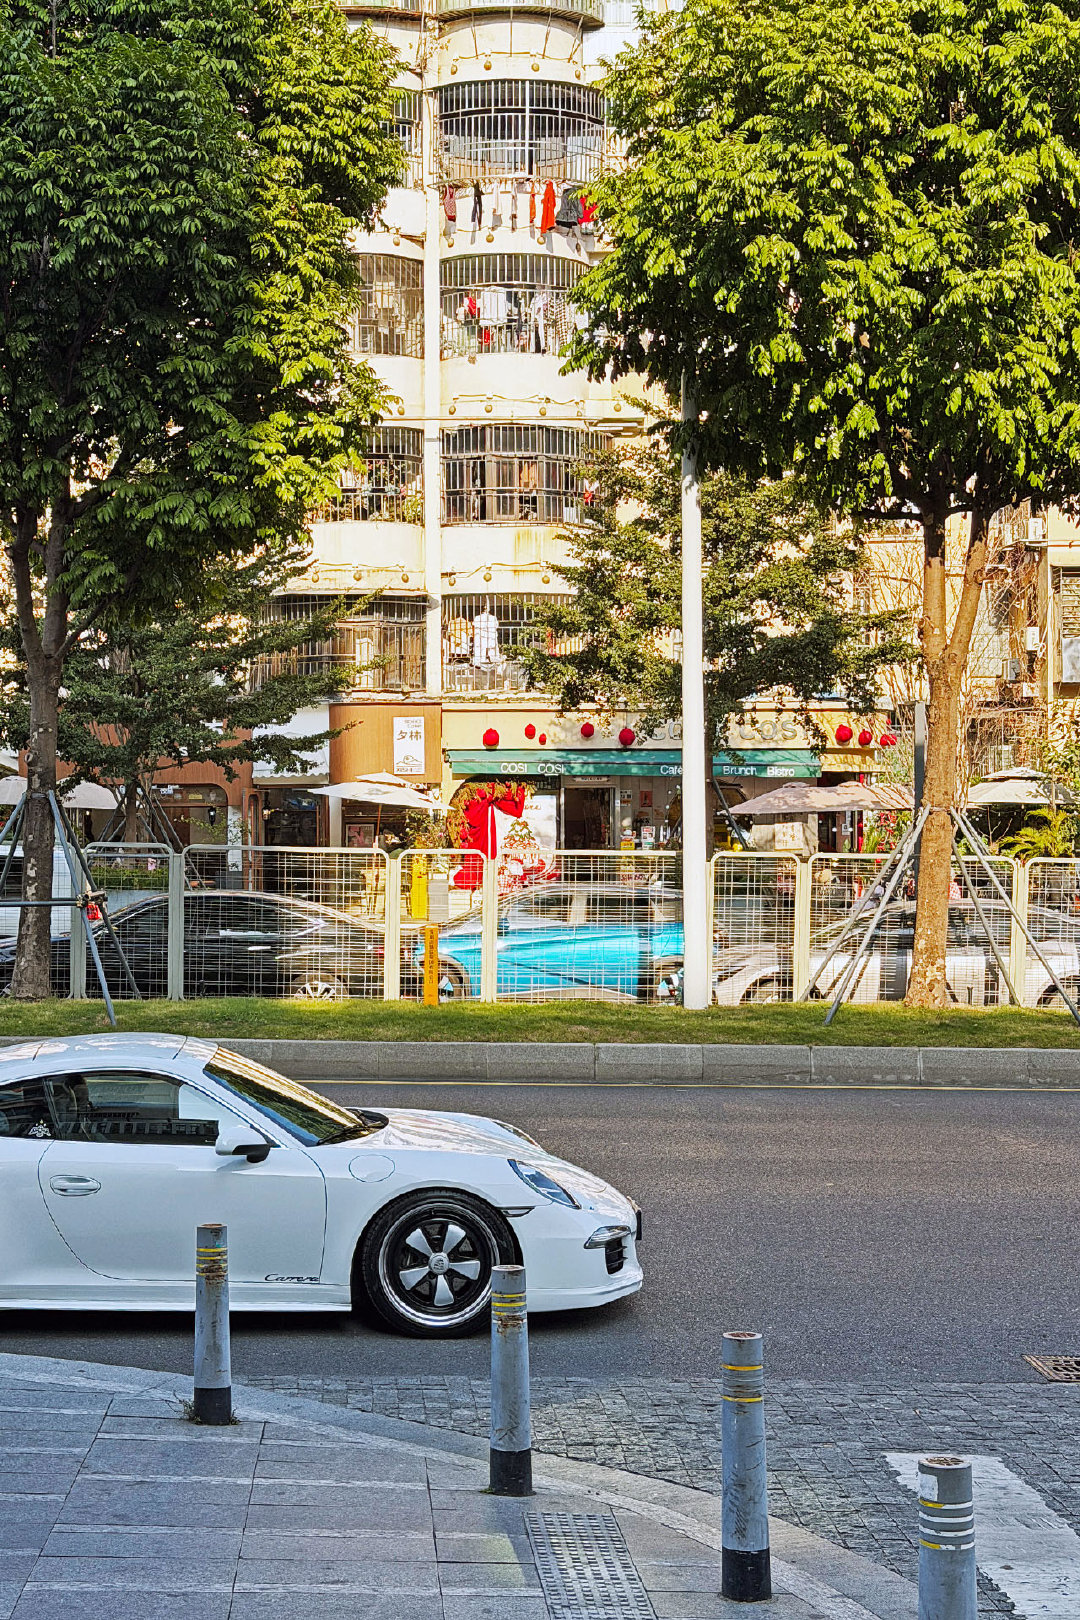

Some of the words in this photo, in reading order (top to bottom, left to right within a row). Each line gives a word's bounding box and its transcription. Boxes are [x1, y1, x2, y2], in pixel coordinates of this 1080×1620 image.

[501, 762, 528, 773] COSI
[537, 763, 564, 774] COSI
[723, 765, 758, 776] Brunch
[766, 766, 795, 777] Bistro
[264, 1273, 320, 1282] Carrera
